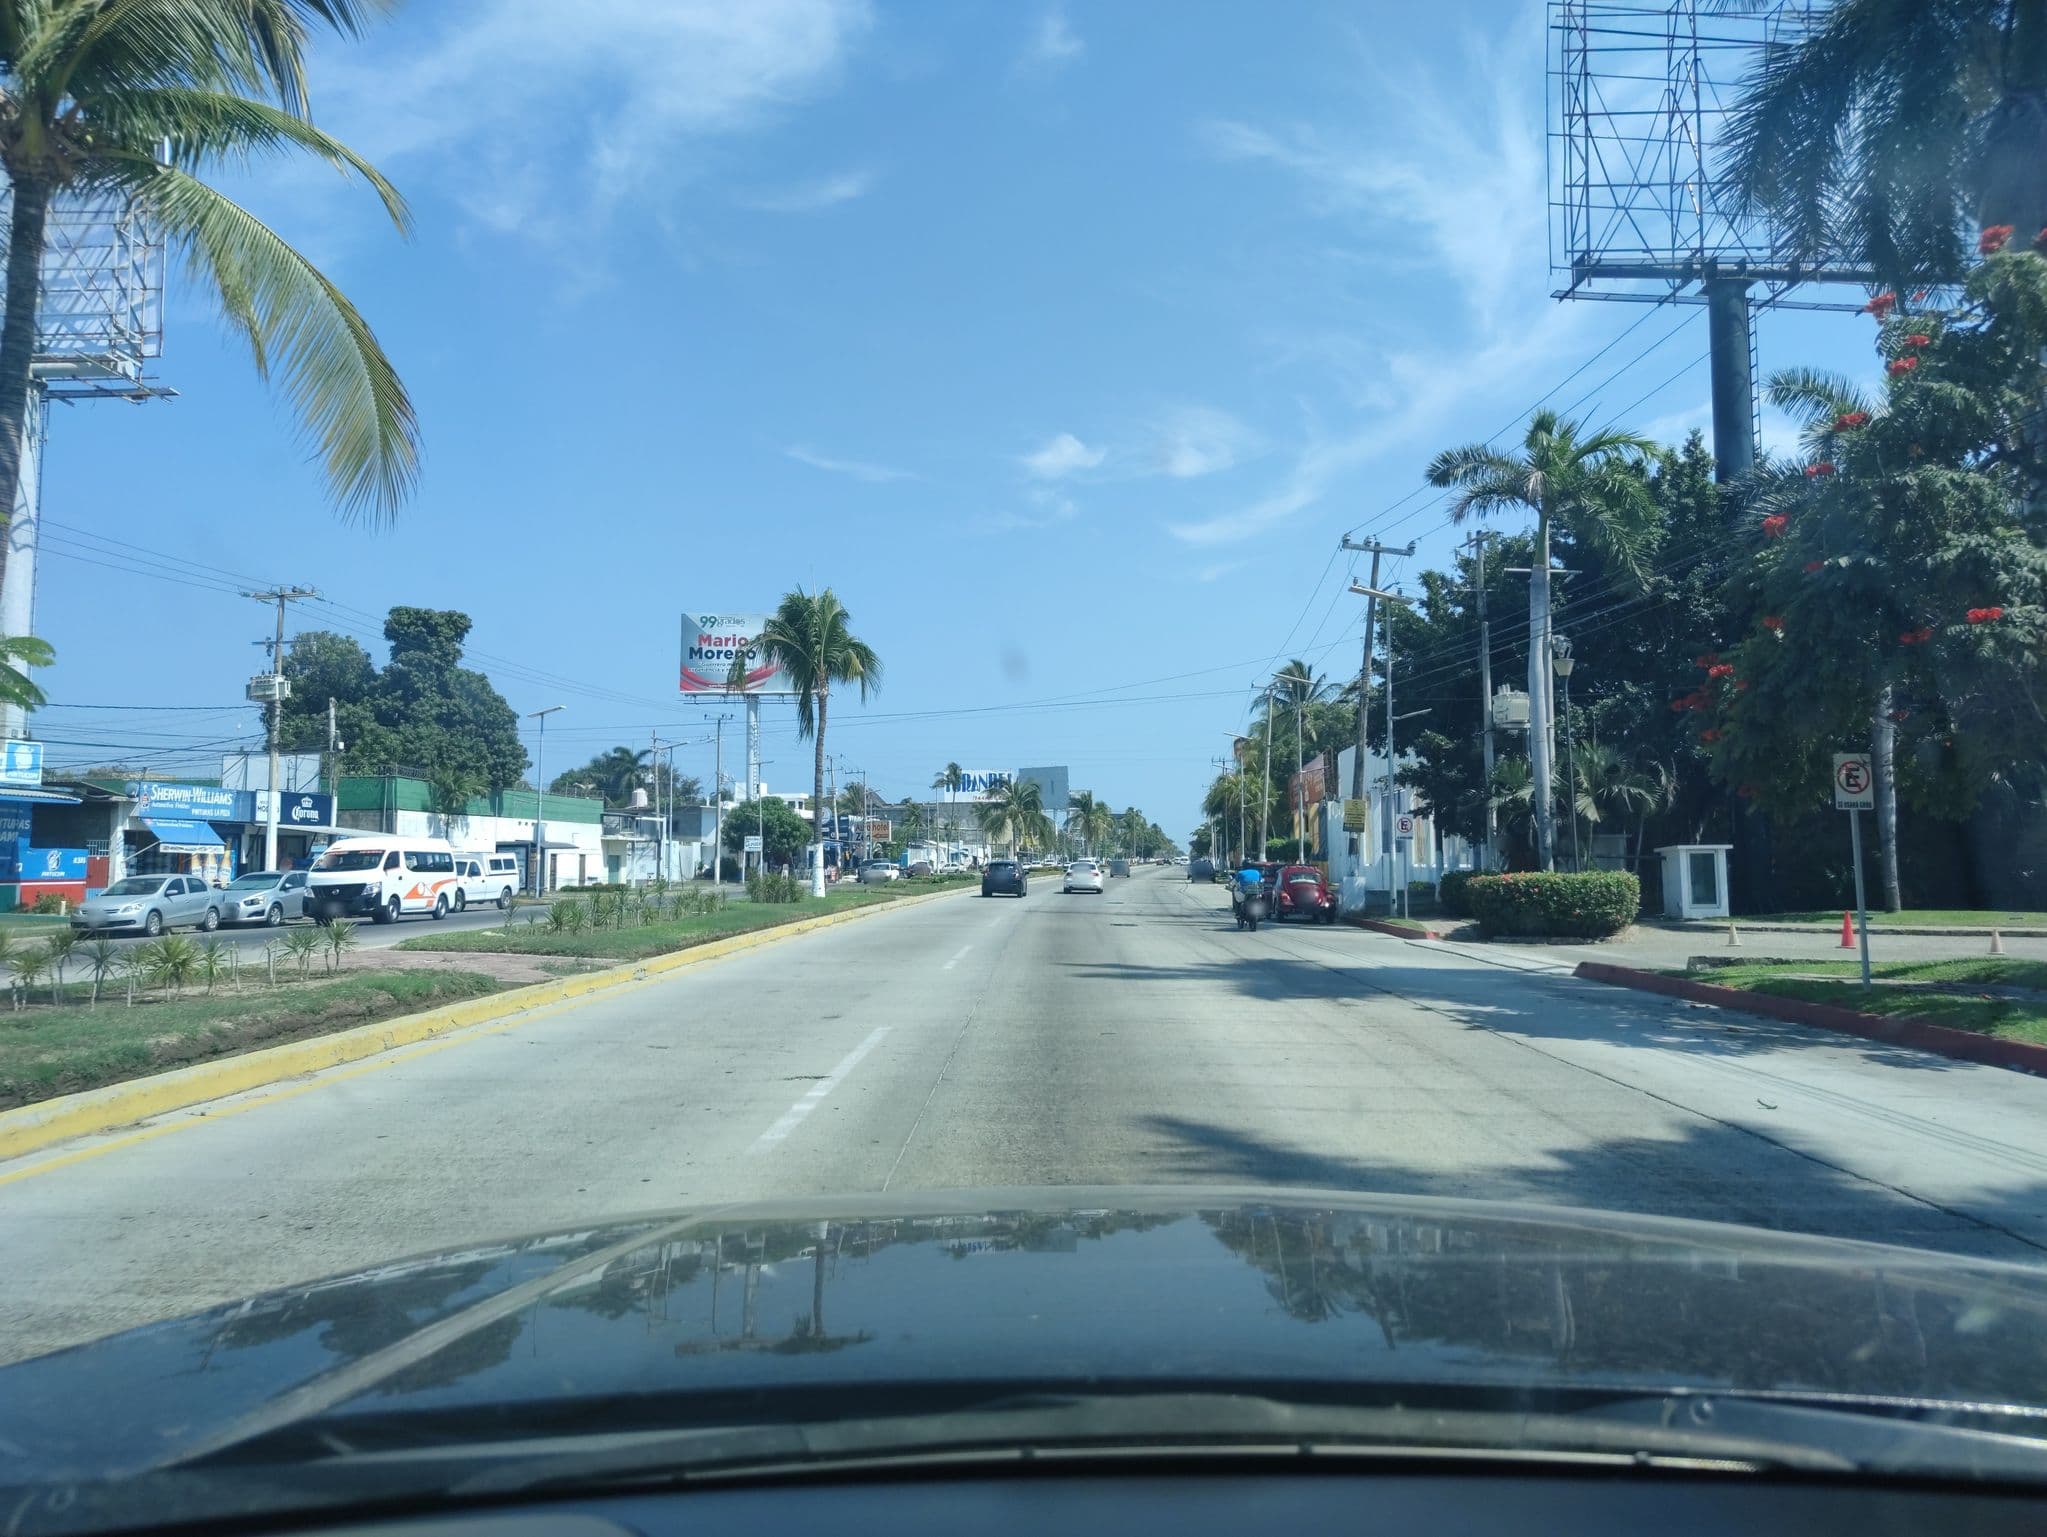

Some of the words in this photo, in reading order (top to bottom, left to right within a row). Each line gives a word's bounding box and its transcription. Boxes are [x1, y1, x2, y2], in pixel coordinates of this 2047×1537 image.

[698, 634, 748, 647] Mario
[689, 647, 756, 660] Moreno
[150, 784, 233, 806] SHERWIN-WILLIAMS
[292, 805, 319, 822] Corona
[873, 822, 889, 832] hotel
